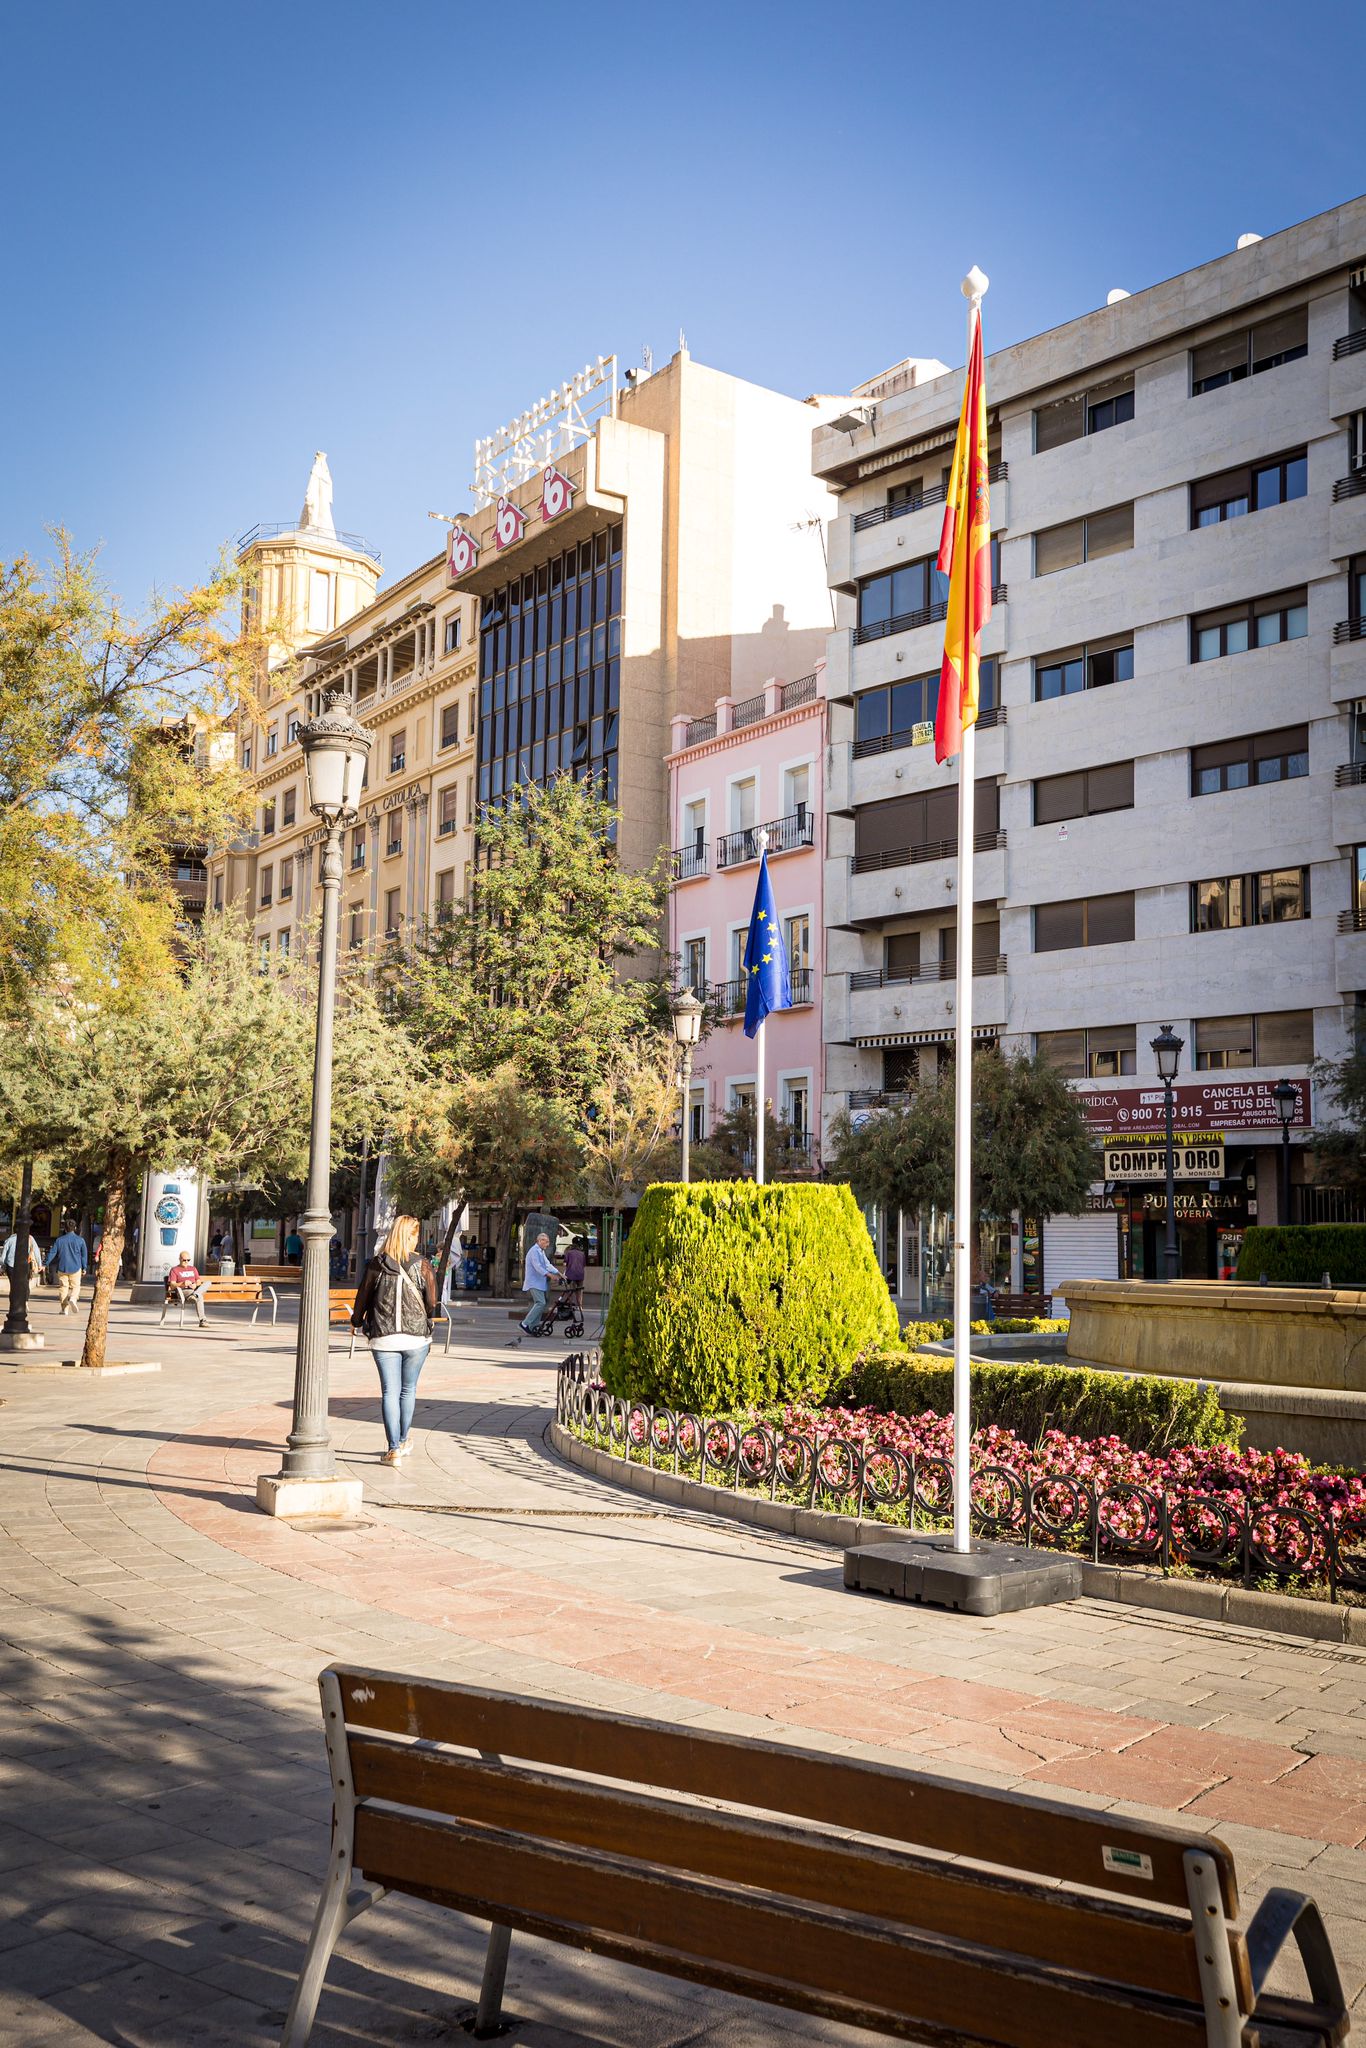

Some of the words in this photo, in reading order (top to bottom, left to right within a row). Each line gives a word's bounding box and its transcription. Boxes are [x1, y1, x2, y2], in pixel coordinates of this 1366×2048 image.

[1203, 1086, 1254, 1098] CANCELA
[1257, 1085, 1271, 1096] EL
[1214, 1100, 1229, 1111] DE
[1231, 1099, 1253, 1110] TUS
[1131, 1108, 1152, 1120] 900
[1181, 1105, 1202, 1117] 915
[1210, 1118, 1246, 1127] EMPRESAS
[1252, 1116, 1304, 1125] PARTICUES
[1149, 1133, 1184, 1145] MONDAS
[1109, 1151, 1180, 1171] COMPRO
[1185, 1150, 1220, 1170] ORO
[1086, 1196, 1115, 1209] ERÍA
